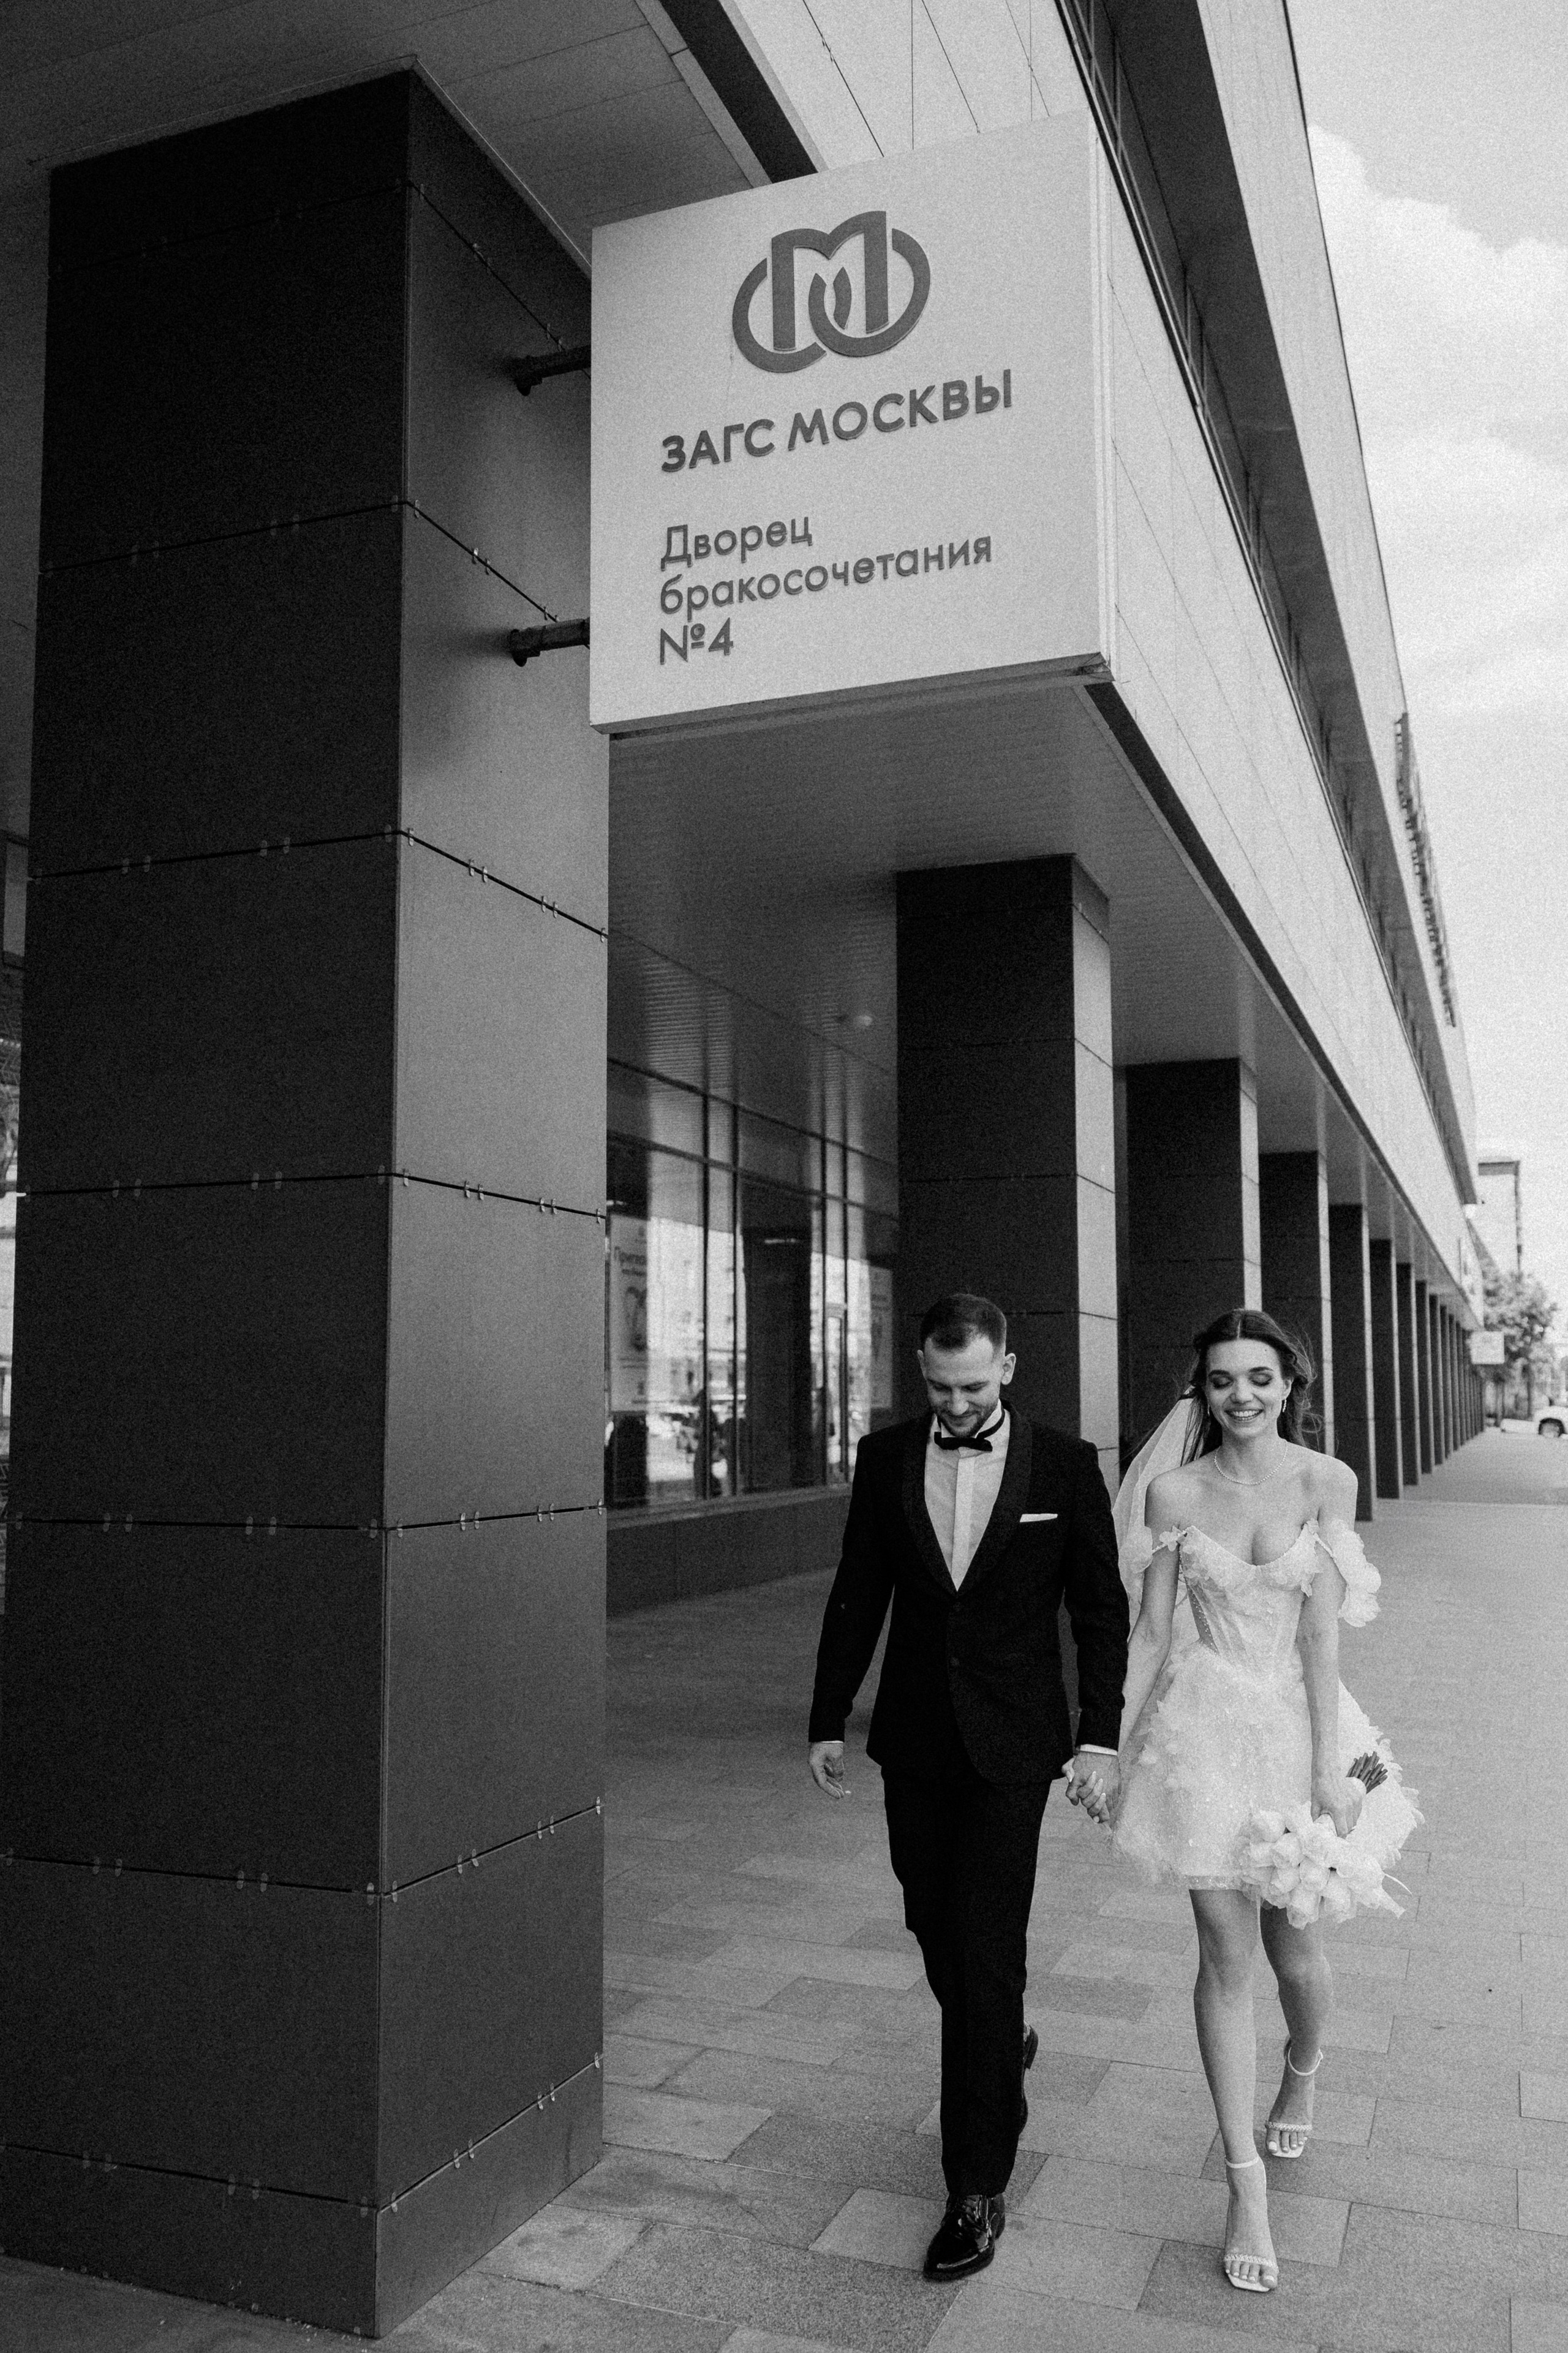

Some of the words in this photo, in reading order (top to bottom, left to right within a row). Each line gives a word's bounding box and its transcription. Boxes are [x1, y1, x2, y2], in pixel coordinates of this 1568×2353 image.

[661, 418, 775, 474] ЗАГС
[787, 369, 1012, 451] МОСКВЫ
[660, 517, 812, 571] Дворец
[660, 537, 992, 622] бракосочетания
[659, 619, 734, 665] №4
